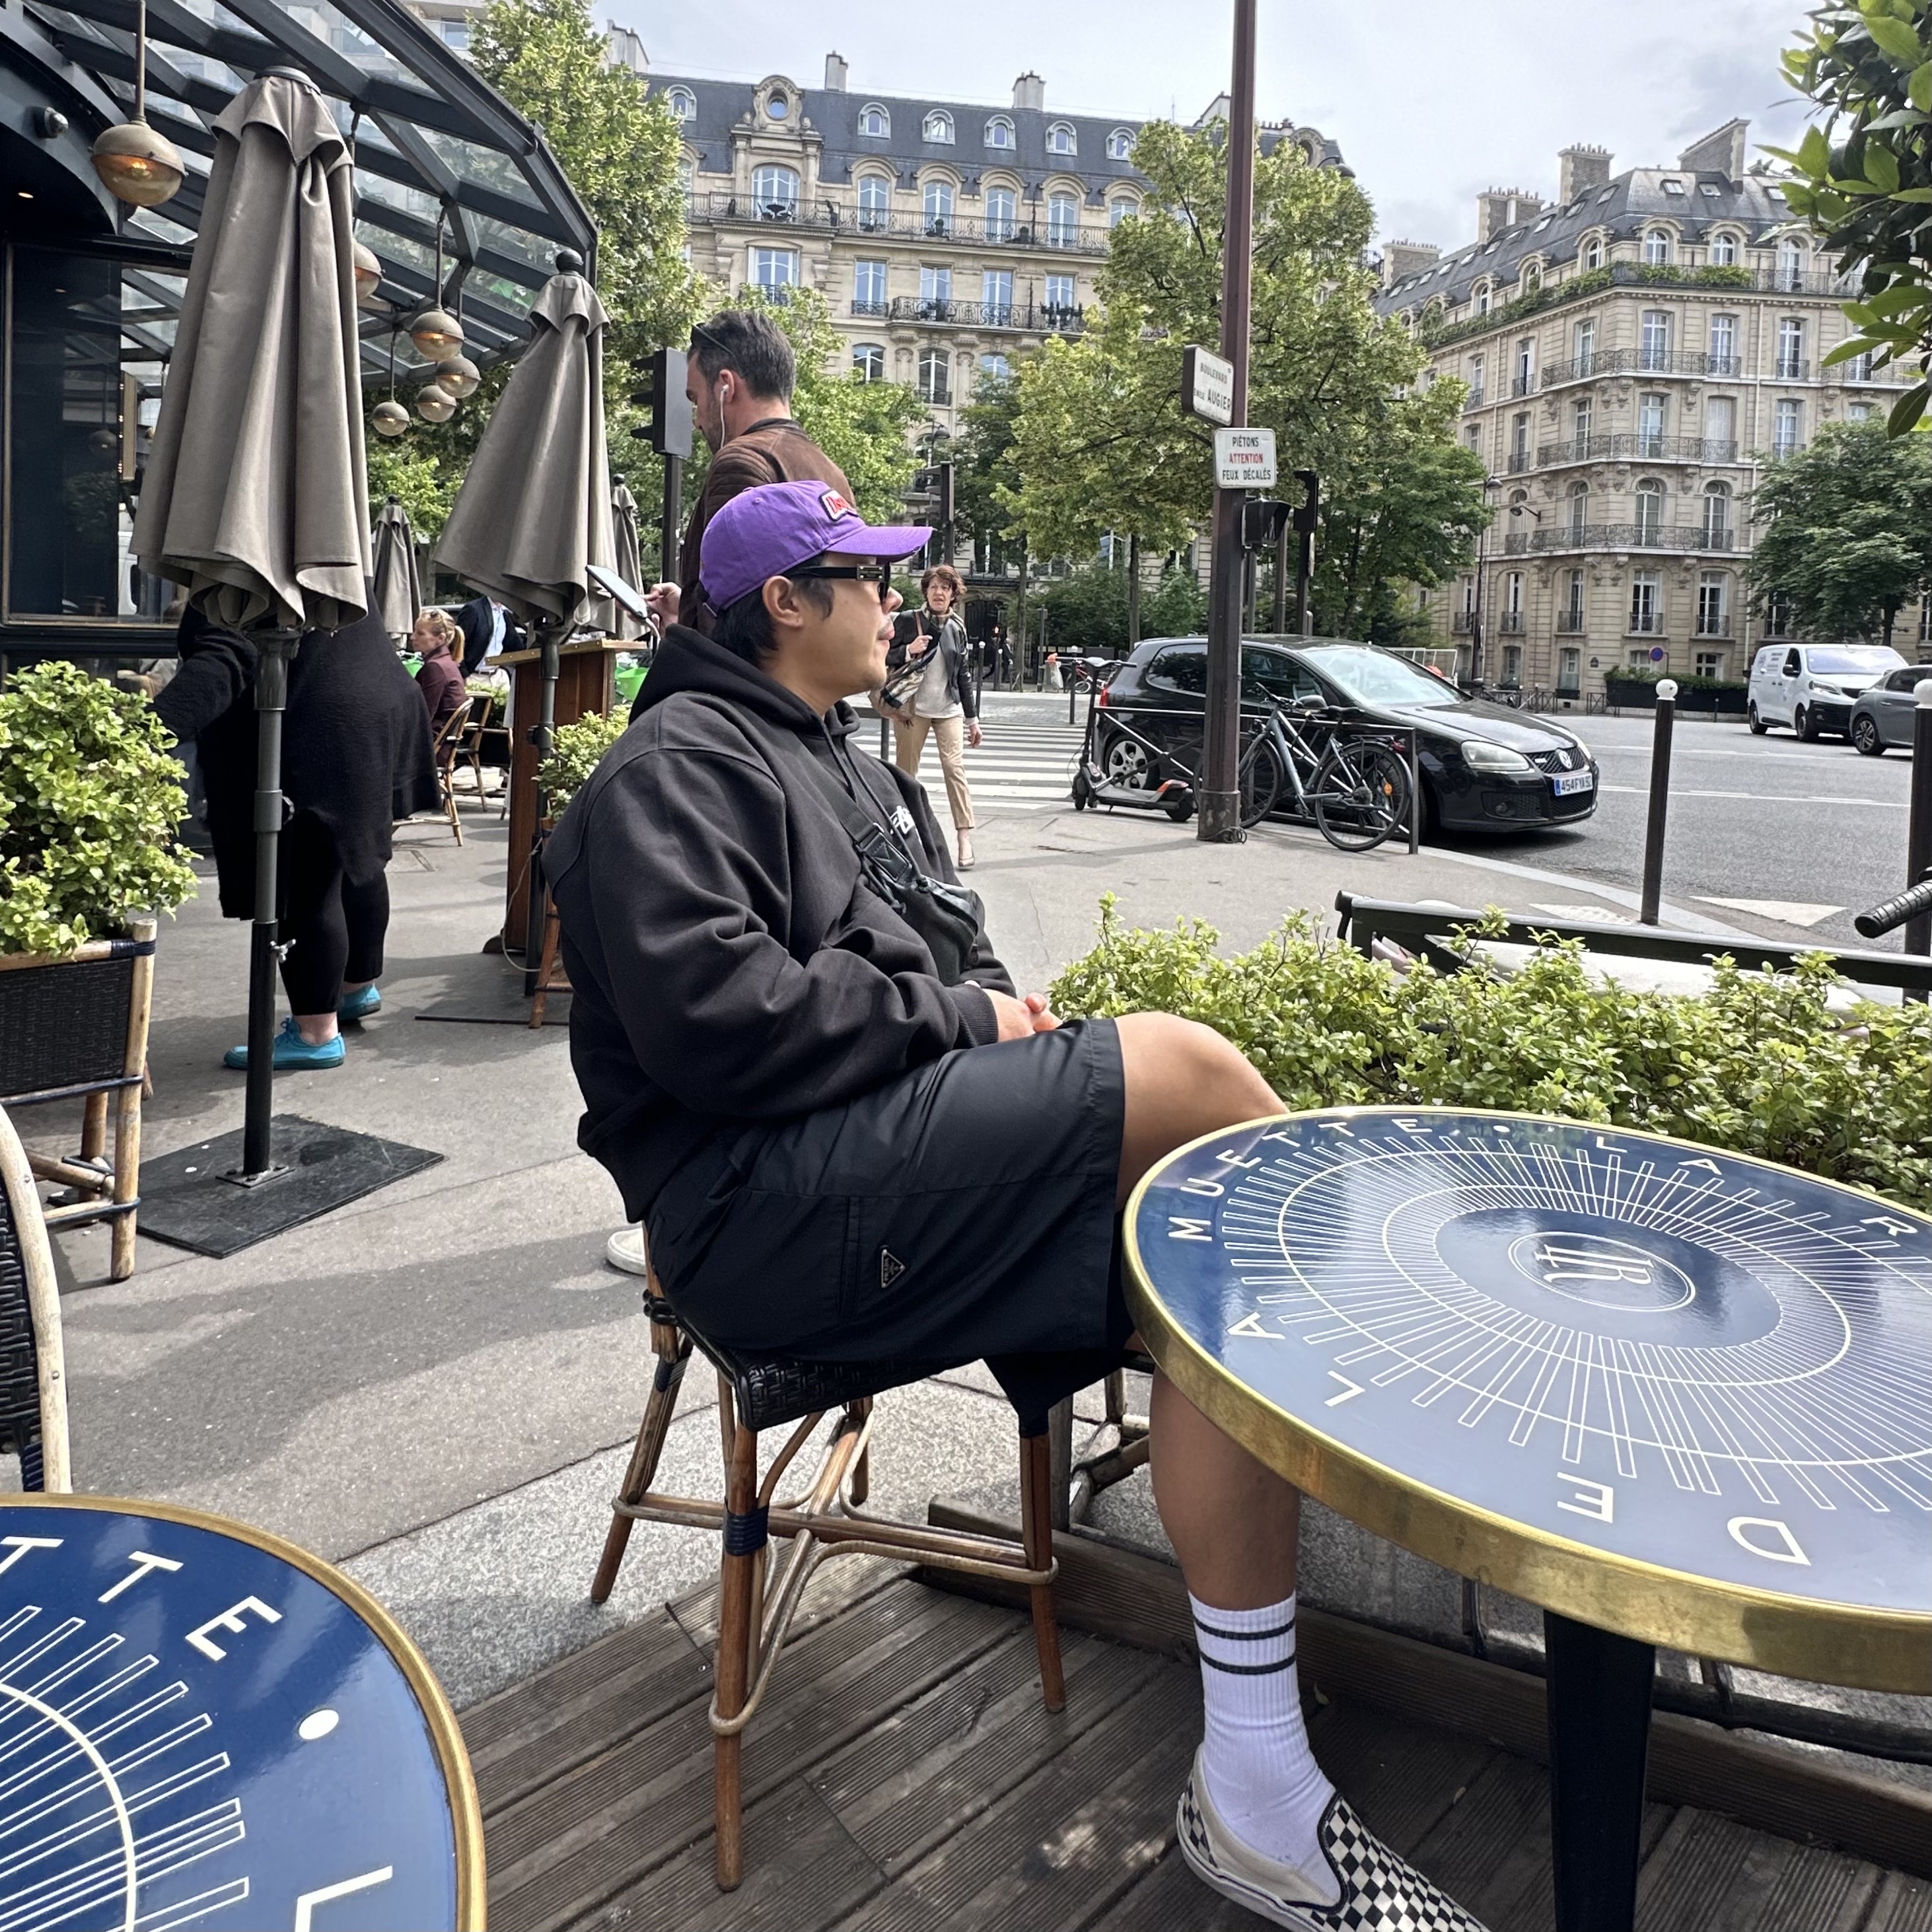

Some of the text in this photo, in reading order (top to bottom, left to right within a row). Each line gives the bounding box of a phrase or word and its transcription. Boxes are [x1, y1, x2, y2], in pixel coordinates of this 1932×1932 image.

[1207, 388, 1231, 410] AUGIER
[1232, 435, 1259, 447] PIÉTONS
[1229, 453, 1264, 464] ATTENTION
[1222, 468, 1271, 480] FEUX DÉCALÉS
[1596, 1135, 1722, 1175] LA
[1168, 1118, 1812, 1566] DE LA MUETTE
